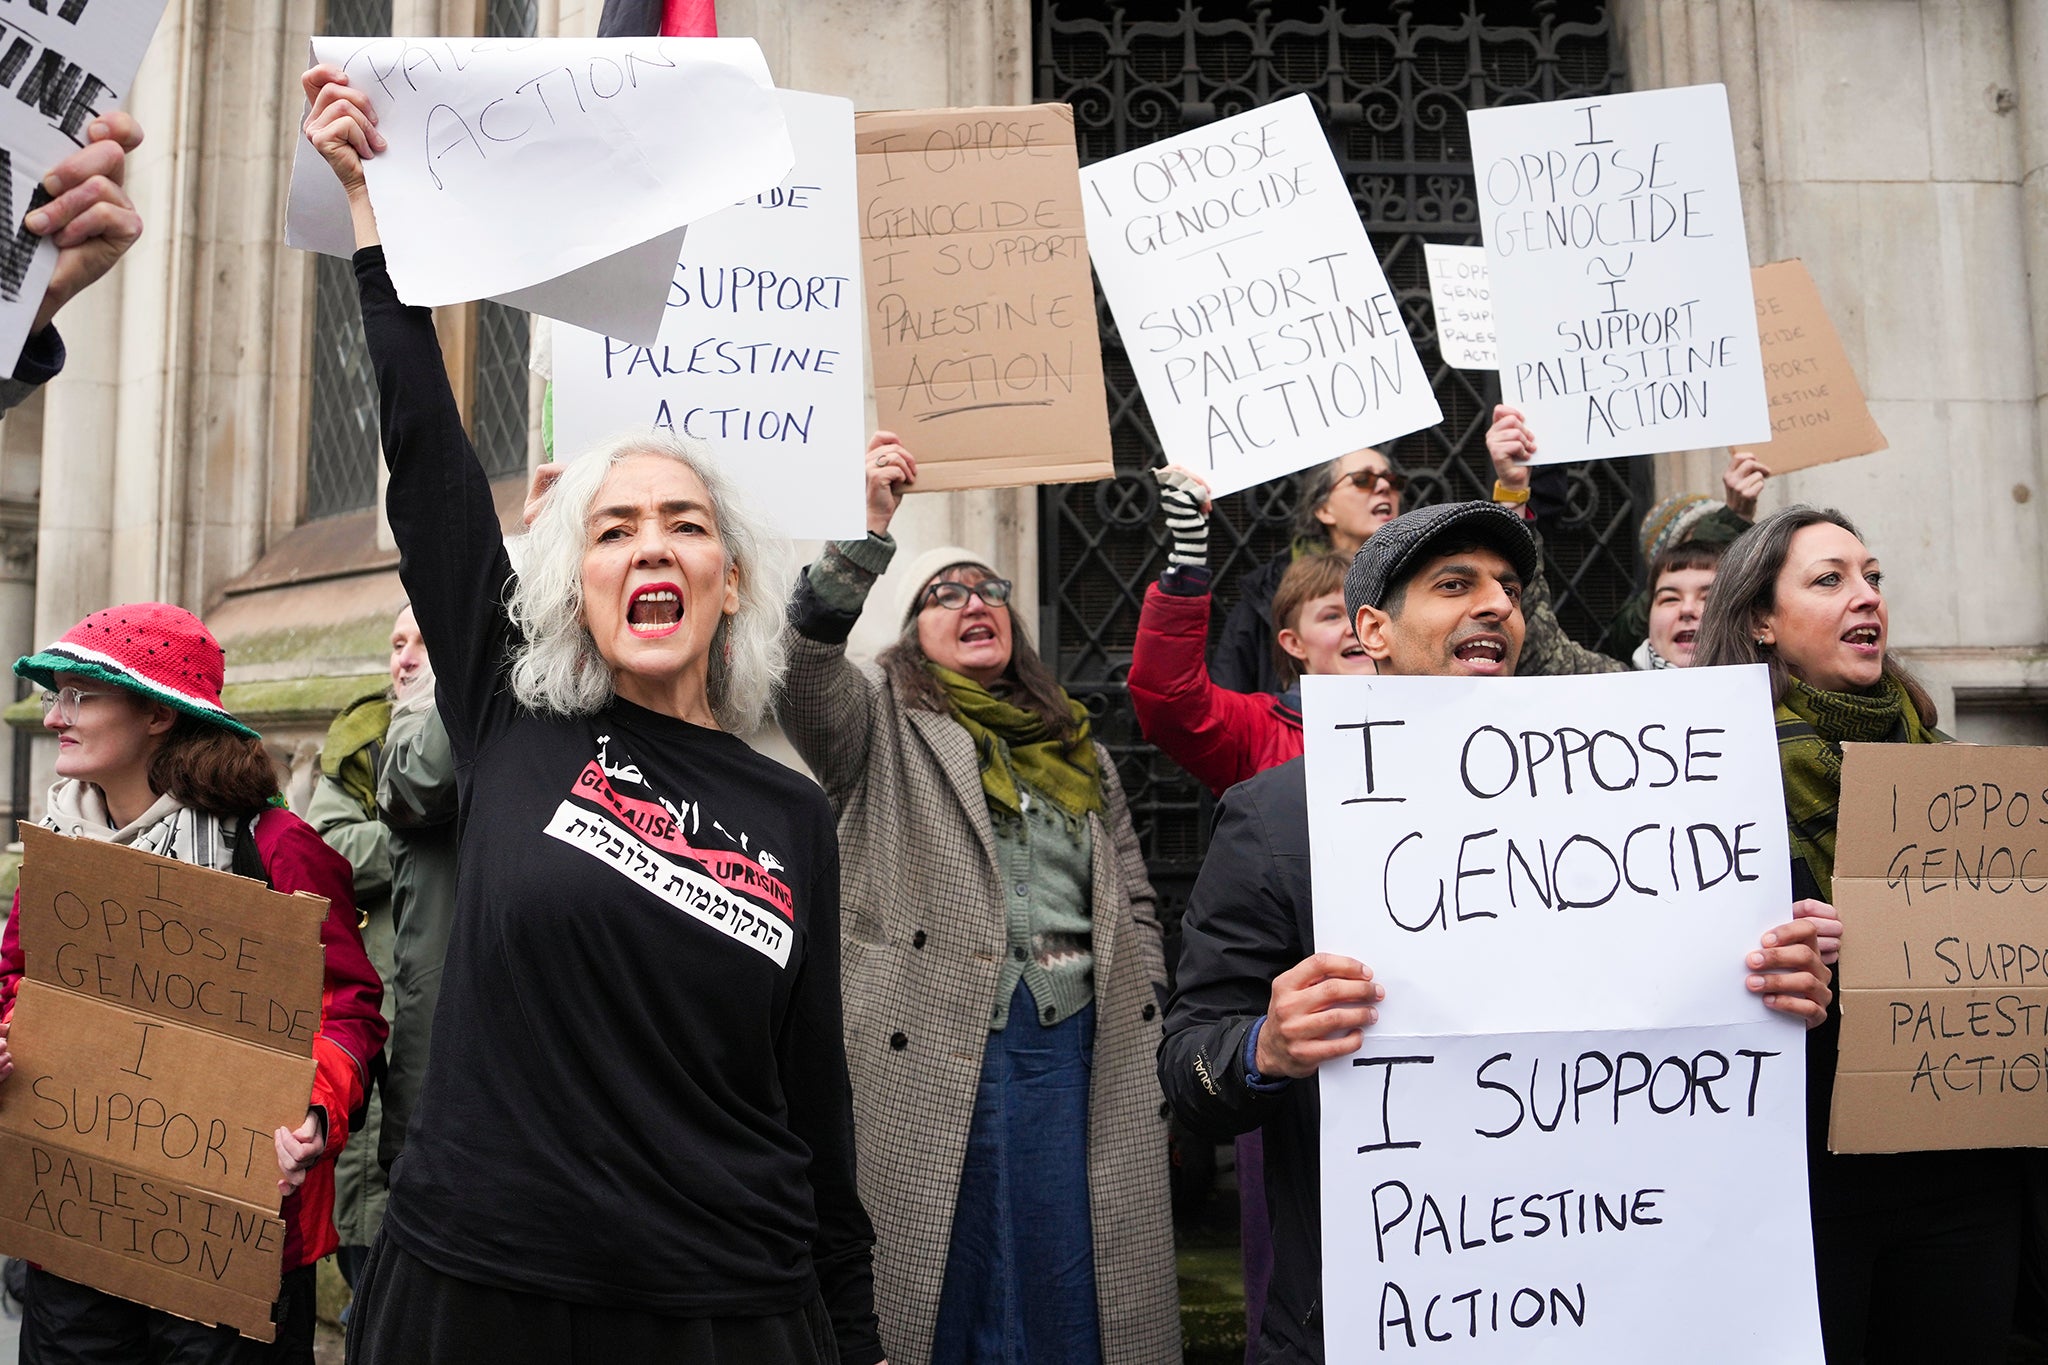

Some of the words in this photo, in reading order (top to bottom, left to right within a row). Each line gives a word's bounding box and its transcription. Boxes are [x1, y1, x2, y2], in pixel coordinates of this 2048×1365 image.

[425, 43, 677, 190] ACTION
[1574, 104, 1614, 146] I
[871, 134, 906, 187] I
[924, 120, 1052, 173] OPPOSE
[1091, 180, 1112, 217] I
[1133, 120, 1286, 204] OPPOSE
[1487, 142, 1677, 206] OPPOSE
[867, 196, 1061, 246] GENOCIDE
[1125, 162, 1317, 255] GENOCIDE
[1494, 189, 1714, 257] GENOCIDE
[666, 262, 850, 312] SUPPORT
[873, 251, 909, 286] I
[933, 235, 1088, 276] SUPPORT
[1217, 252, 1231, 279] I
[1432, 258, 1453, 279] I
[877, 294, 1073, 346] PALESTINE
[1139, 252, 1348, 353] SUPPORT
[1438, 307, 1451, 322] I
[1558, 299, 1700, 352] SUPPORT
[1597, 279, 1629, 314] I
[605, 336, 840, 379] PALESTINE
[898, 341, 1073, 411] ACTION
[1164, 293, 1400, 404] PALESTINE
[1516, 336, 1738, 402] PALESTINE
[651, 399, 813, 444] ACTION
[1207, 338, 1402, 470] ACTION
[1587, 380, 1707, 444] ACTION
[1334, 719, 1406, 806] I
[1460, 723, 1725, 799] OPPOSE
[1892, 784, 1897, 833] I
[565, 818, 660, 882] גלובלית
[1383, 821, 1762, 933] GENOCIDE
[143, 862, 182, 907] I
[663, 874, 783, 950] התקוממות
[716, 862, 792, 910] UPRISING
[54, 890, 263, 972] OPPOSE
[1903, 940, 1912, 979] I
[1935, 937, 2048, 985] SUPP
[56, 942, 313, 1042] GENOCIDE
[120, 1022, 164, 1081] I
[32, 1075, 274, 1178] SUPPORT
[1353, 1055, 1434, 1154] I
[1474, 1049, 1783, 1139] SUPPORT
[32, 1147, 280, 1253] PALESTINE
[1371, 1179, 1666, 1264] PALESTINE
[26, 1190, 233, 1280] ACTION
[1379, 1281, 1587, 1352] ACTION
